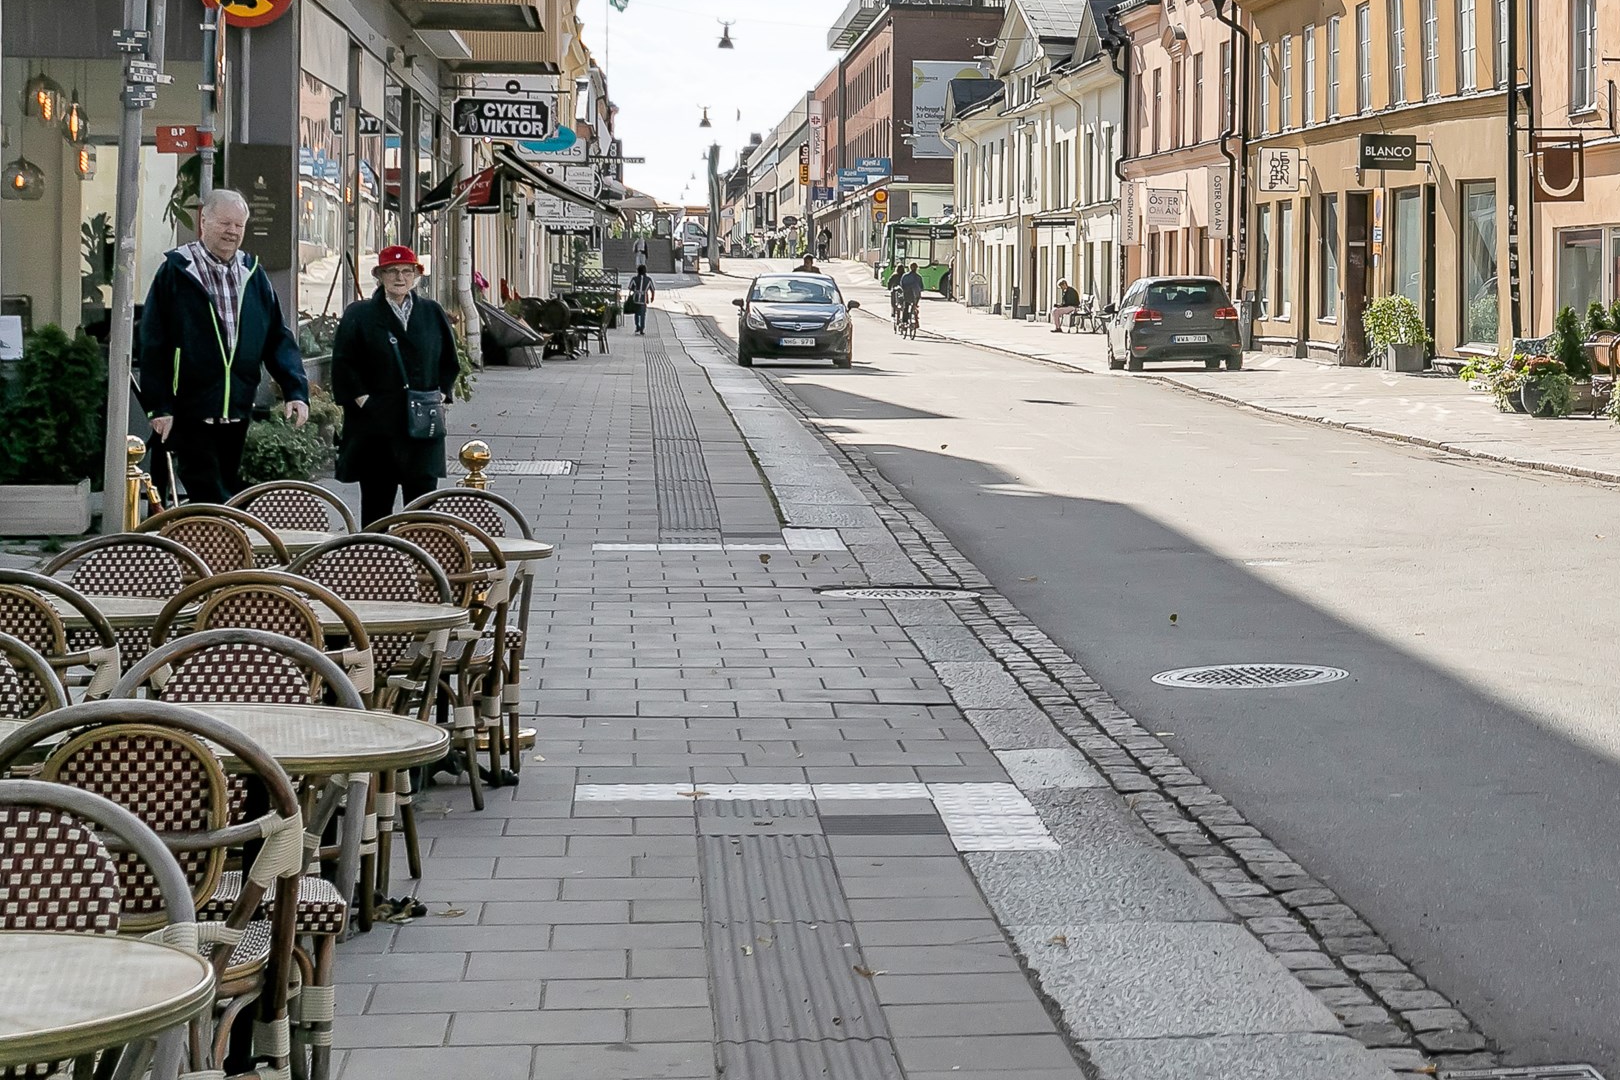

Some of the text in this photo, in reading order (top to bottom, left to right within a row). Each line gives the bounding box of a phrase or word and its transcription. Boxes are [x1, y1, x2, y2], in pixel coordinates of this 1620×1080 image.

[483, 102, 542, 119] CYKEL
[171, 128, 186, 137] BP
[480, 118, 544, 136] VIKTOR
[1365, 146, 1412, 157] BLANCO
[1149, 193, 1178, 205] ÖSTER
[1214, 175, 1224, 231] ÖSTER OM ÅN
[1149, 206, 1164, 215] OM
